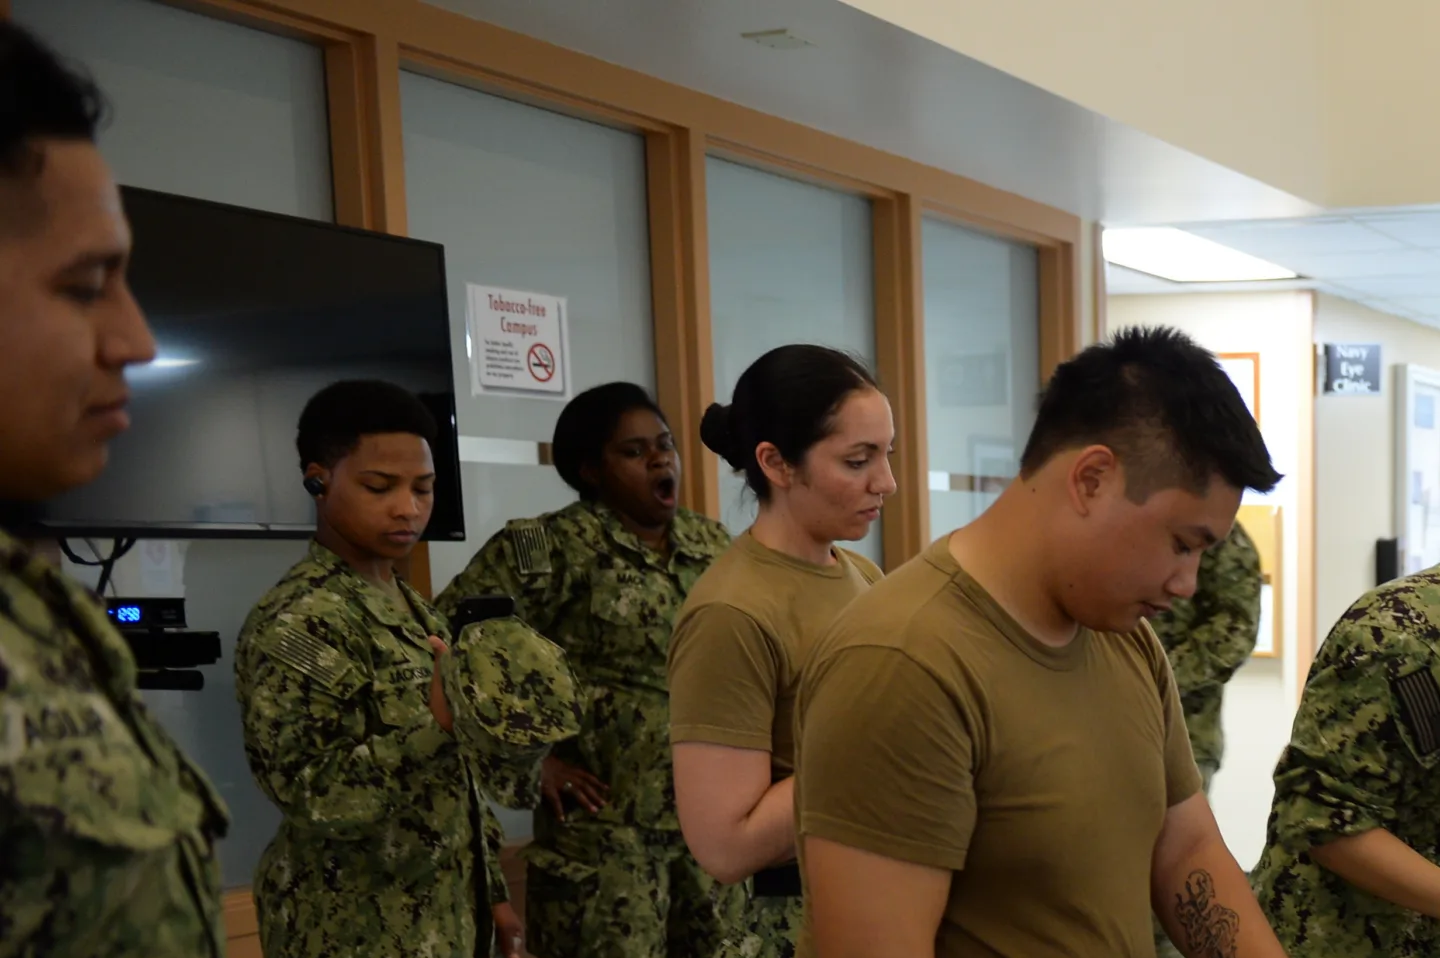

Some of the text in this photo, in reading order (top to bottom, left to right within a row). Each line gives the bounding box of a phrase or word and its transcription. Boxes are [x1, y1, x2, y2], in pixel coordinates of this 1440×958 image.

[488, 293, 546, 317] Tobacco-free
[501, 316, 538, 338] Campus
[1336, 345, 1368, 361] Navy
[1340, 361, 1364, 378] Eye
[1333, 378, 1371, 393] Clinic
